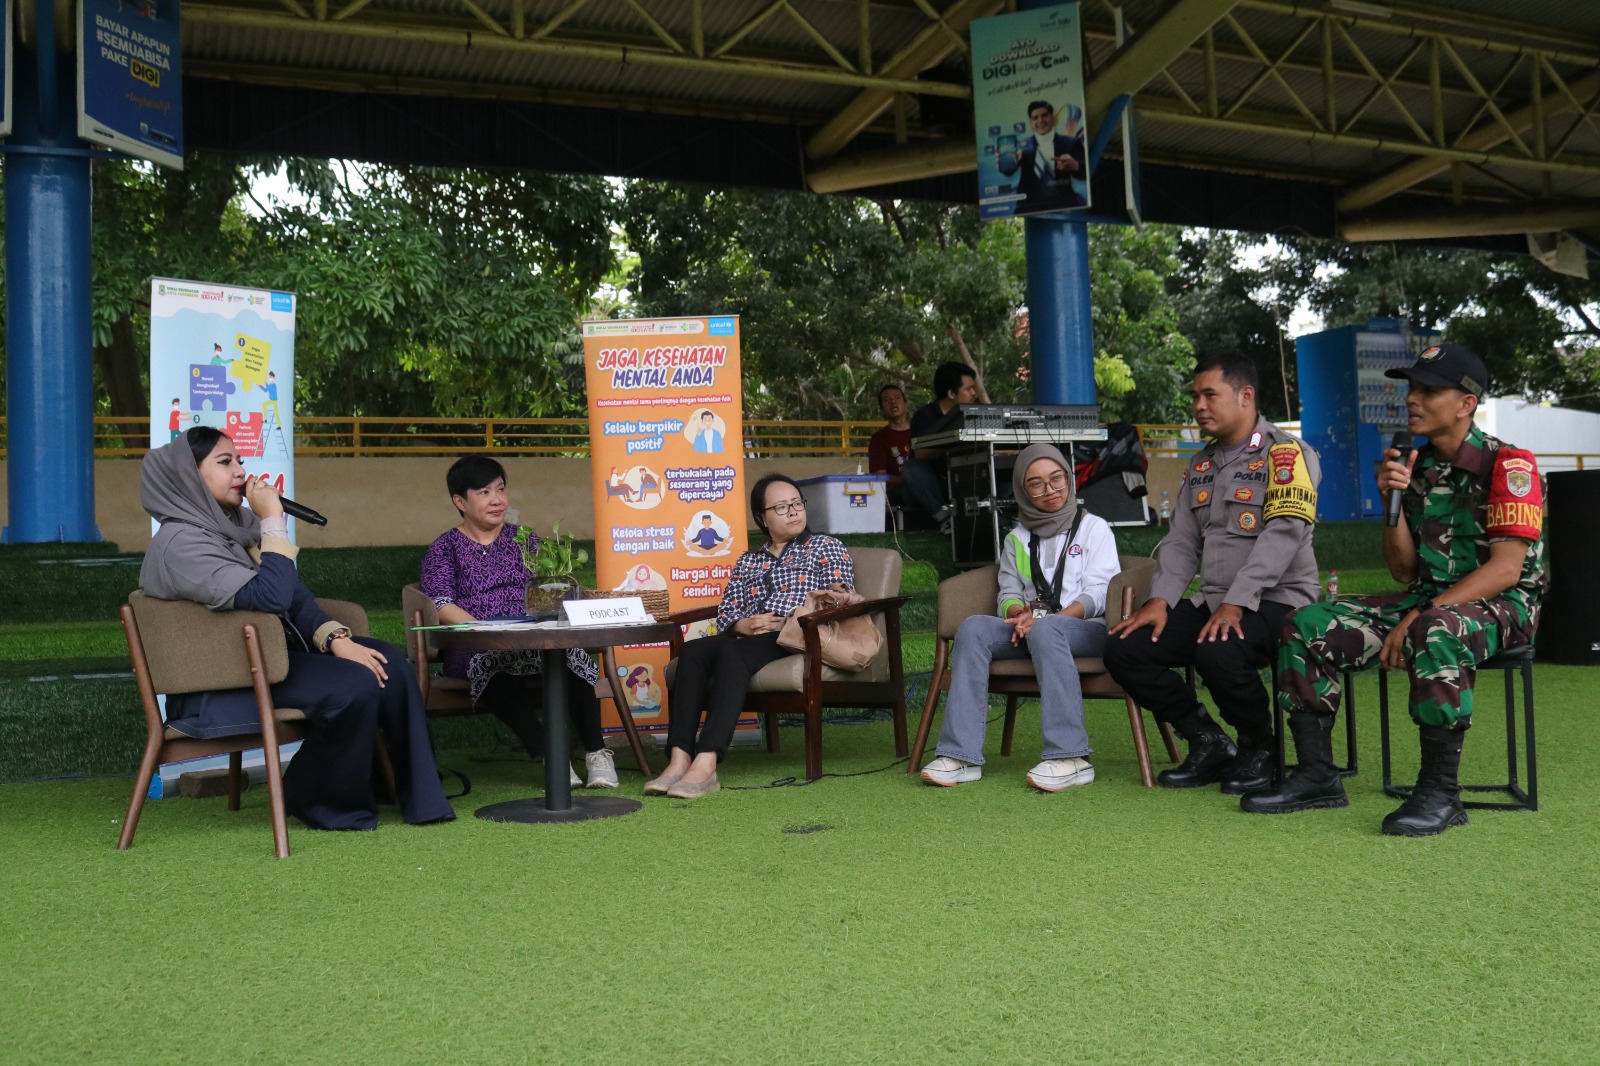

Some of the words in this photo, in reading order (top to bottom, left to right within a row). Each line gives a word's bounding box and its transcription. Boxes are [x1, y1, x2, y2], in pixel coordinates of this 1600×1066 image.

[96, 14, 129, 37] BAYAR
[131, 30, 170, 56] APAPUN
[96, 30, 170, 71] #SEMUABISA
[1011, 37, 1036, 50] AYO
[990, 44, 1060, 64] DOWNLOAD
[101, 48, 128, 67] PAKE
[132, 62, 158, 84] DIGI
[983, 64, 1016, 80] DIGI
[599, 350, 638, 368] JAGA
[644, 347, 726, 367] KESEHATAN
[612, 368, 666, 388] MENTAL
[672, 367, 713, 386] ANDA
[652, 397, 679, 407] pentingnya
[680, 397, 697, 406] dengan
[605, 422, 636, 434] Selalu
[638, 420, 683, 435] berpikir
[628, 438, 663, 453] positif
[666, 468, 712, 479] terbukalah
[714, 467, 735, 479] pada
[1234, 472, 1266, 482] POLRI
[670, 480, 710, 490] seseorang
[712, 480, 732, 491] yang
[680, 490, 724, 501] dipercayai
[612, 528, 643, 539] Kelola
[646, 527, 674, 537] stress
[614, 540, 649, 553] dengan
[653, 539, 674, 550] baik
[672, 567, 708, 583] Hargai
[712, 566, 731, 579] diri
[684, 586, 721, 598] sendiri
[589, 608, 630, 619] PODCAST
